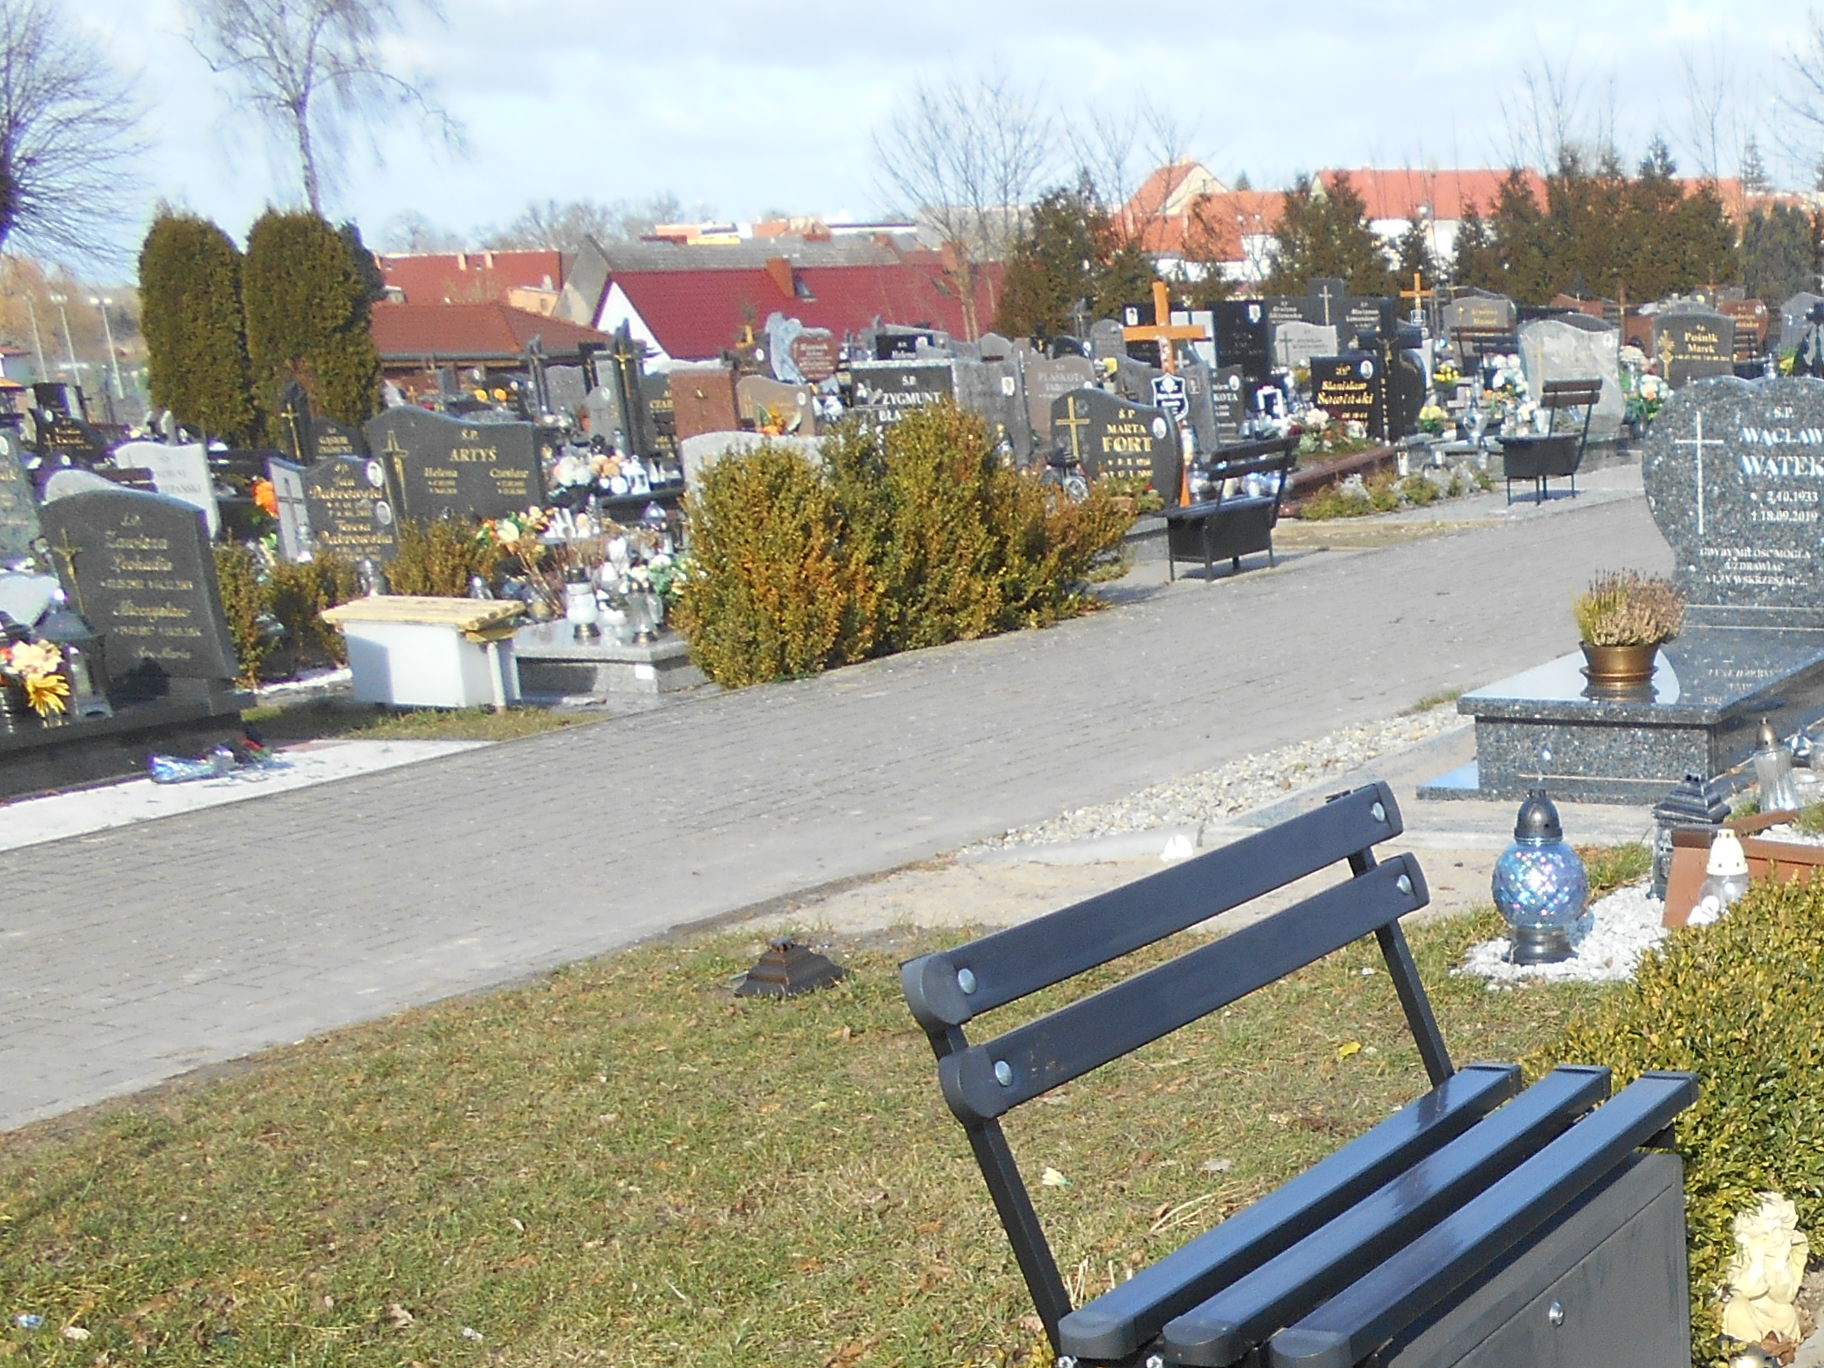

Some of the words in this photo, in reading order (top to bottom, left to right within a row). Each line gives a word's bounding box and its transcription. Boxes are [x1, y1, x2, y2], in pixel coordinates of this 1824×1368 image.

[882, 392, 941, 405] ZYGMUNT
[1106, 424, 1147, 434] MARTA
[1102, 437, 1152, 452] FORT
